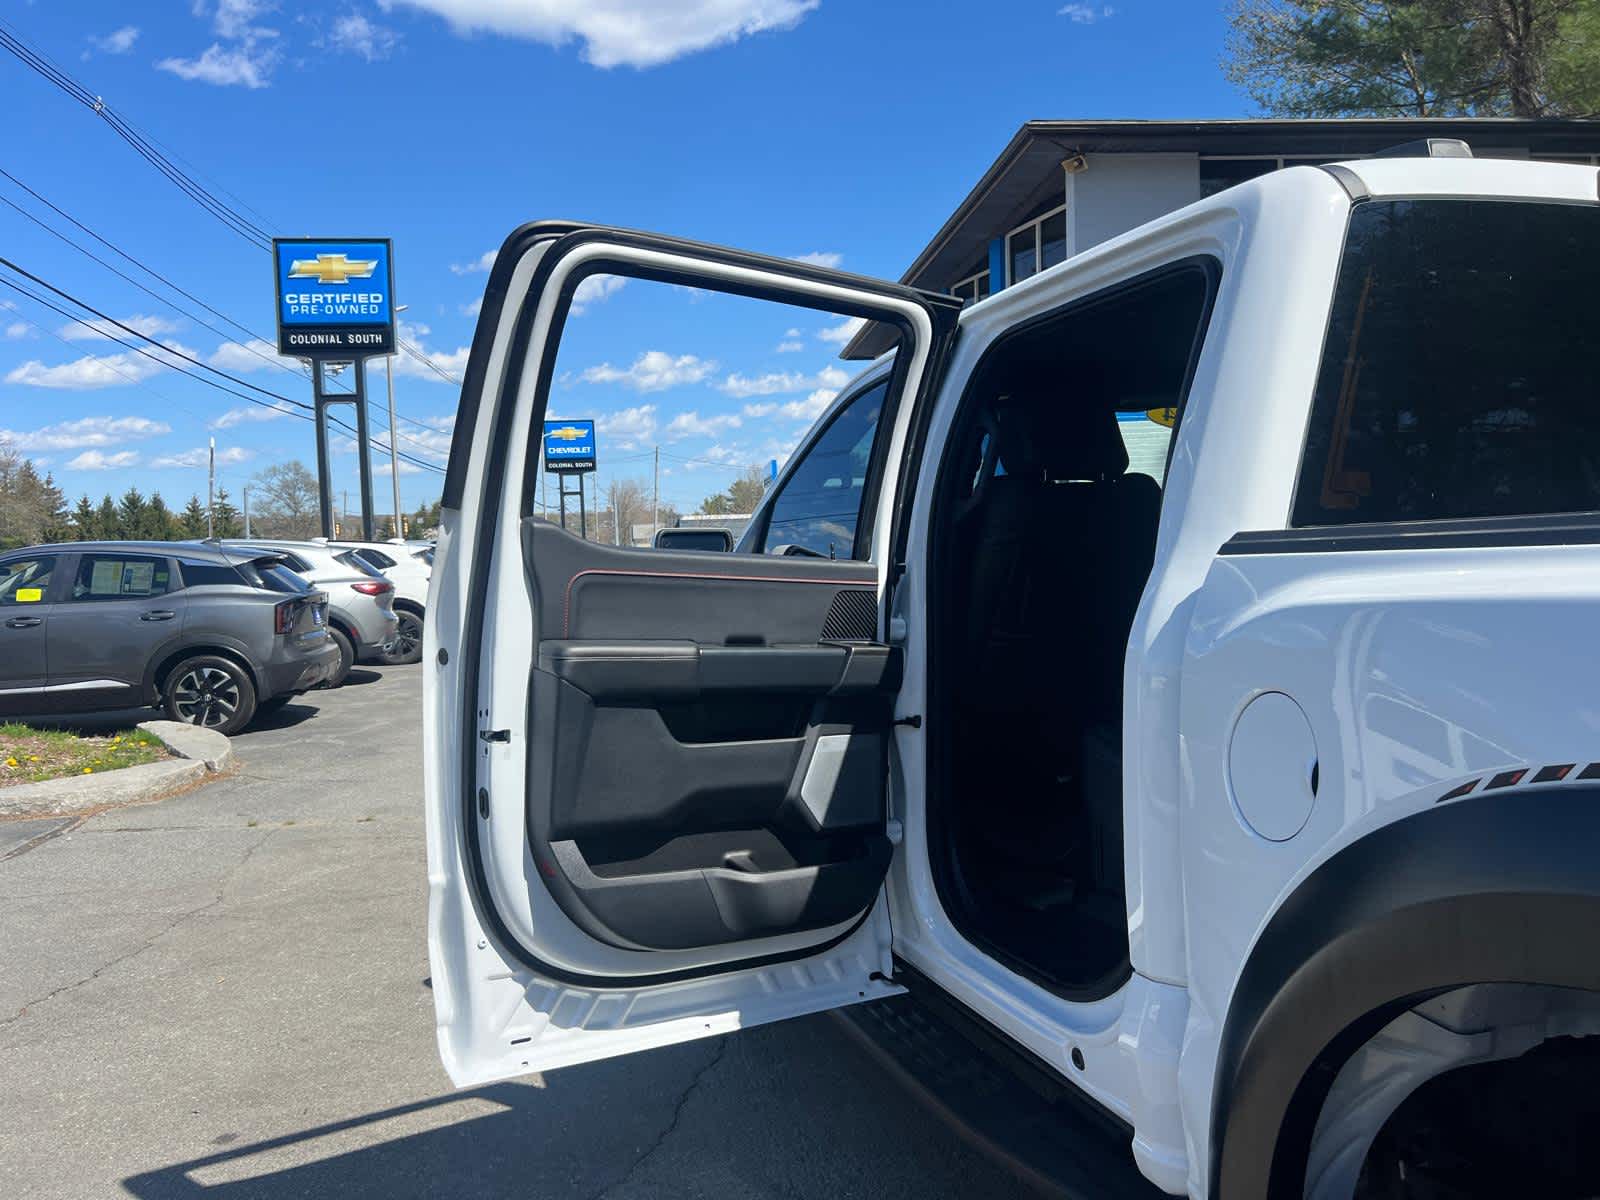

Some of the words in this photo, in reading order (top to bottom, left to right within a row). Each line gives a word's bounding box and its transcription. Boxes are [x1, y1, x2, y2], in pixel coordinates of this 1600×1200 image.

[285, 293, 383, 304] CERTIFIED
[290, 304, 379, 315] PRE-OWNED
[290, 334, 342, 344] COLONIAL
[348, 334, 383, 344] SOUTH
[548, 446, 591, 454] CHEVROLET
